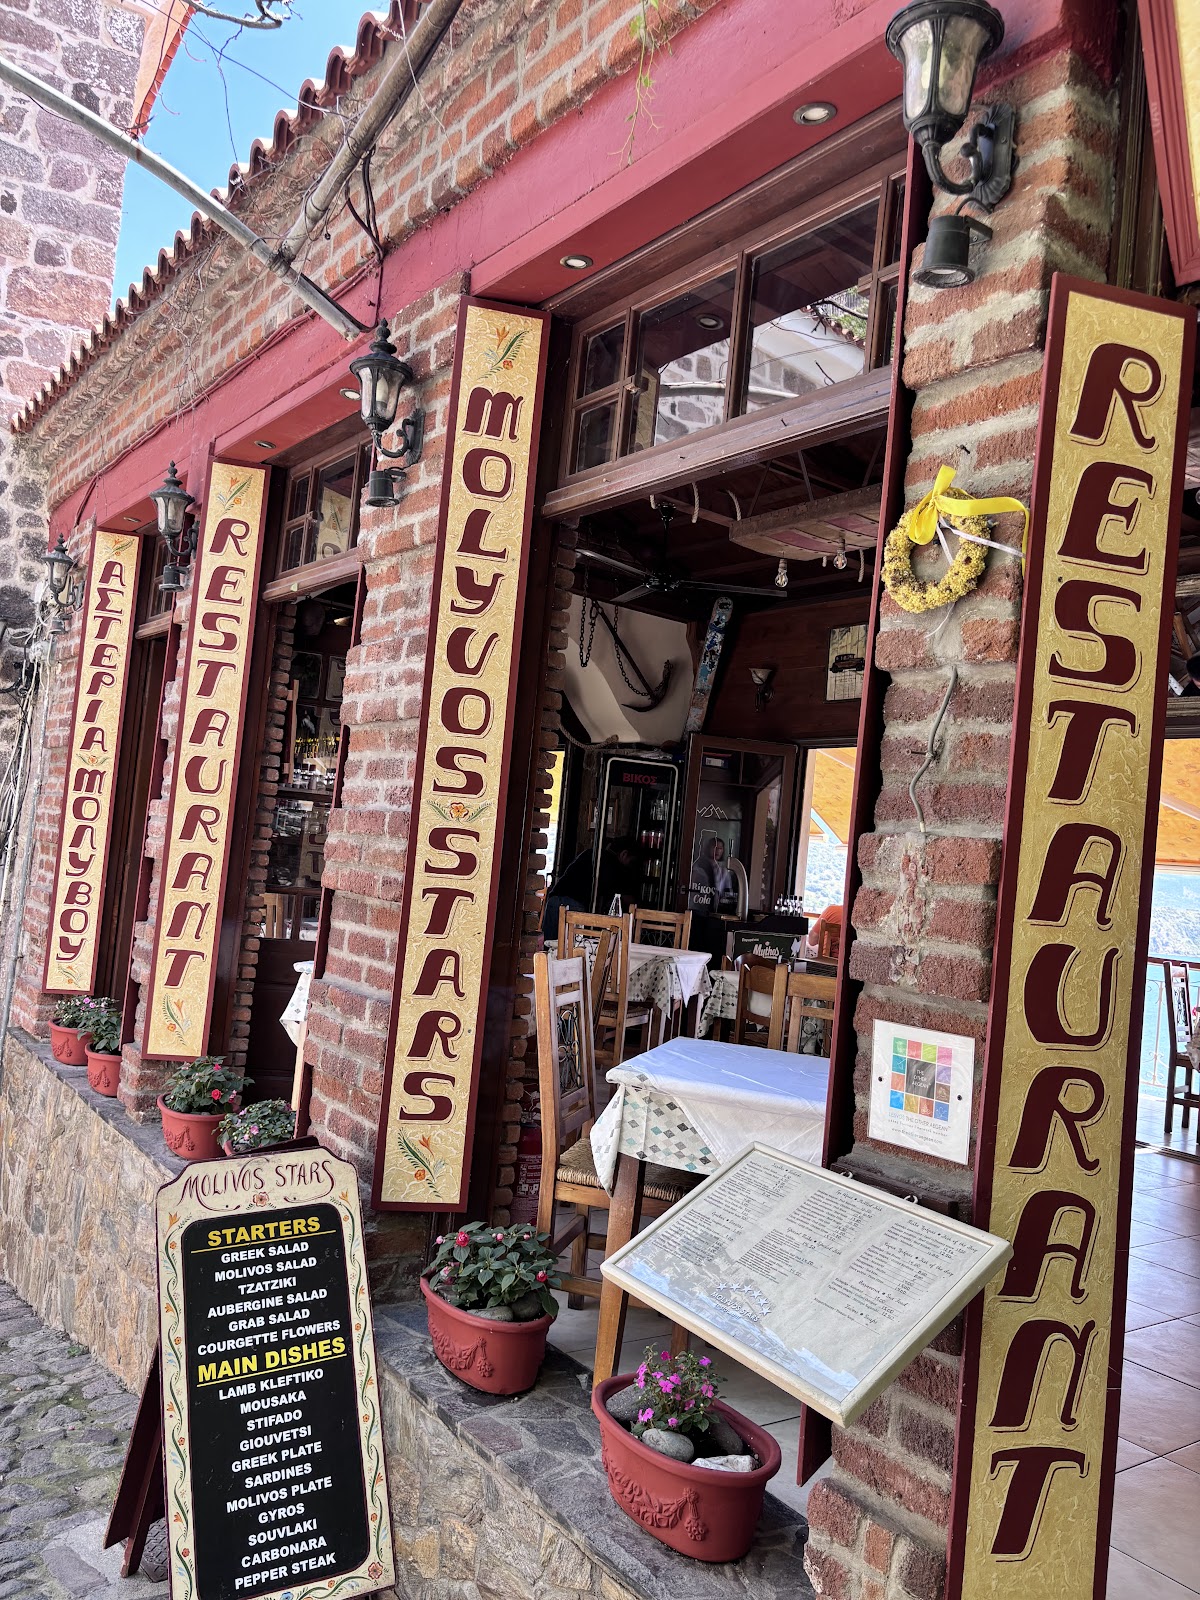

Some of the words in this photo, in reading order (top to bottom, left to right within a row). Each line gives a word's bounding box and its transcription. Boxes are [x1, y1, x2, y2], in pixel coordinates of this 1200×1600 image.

[433, 386, 524, 796] MOLYVOS
[164, 518, 251, 987] RESTAURANT
[693, 895, 711, 905] Cola
[753, 944, 780, 958] Mythos
[988, 342, 1164, 1558] RESTAURANT
[398, 827, 480, 1122] STARS
[177, 1158, 265, 1206] MOLIVOS
[275, 1160, 335, 1201] STARS
[208, 1216, 320, 1247] STARTERS
[221, 1248, 264, 1263] GREEK
[268, 1242, 309, 1256] SALAD
[215, 1264, 273, 1282] MOLIVOS
[276, 1257, 316, 1272] SALAD
[238, 1277, 296, 1295] TZATZIKI
[208, 1297, 283, 1318] AUBERGINE
[287, 1288, 327, 1303] SALAD
[228, 1317, 265, 1332] GRAB
[269, 1309, 310, 1324] SALAD
[198, 1332, 278, 1355] COURGETTE
[282, 1320, 340, 1338] FLOWERS
[198, 1354, 258, 1382] MAIN
[265, 1337, 345, 1363] DISHES
[219, 1384, 256, 1400] LAMB
[260, 1368, 323, 1391] KLEFTIKO
[240, 1390, 306, 1414] MOUSAKA
[247, 1410, 302, 1431] STIFADO
[240, 1425, 312, 1451] GIOUVETSI
[232, 1451, 278, 1472] GREEK
[281, 1441, 322, 1460] PLATE
[245, 1463, 312, 1488] SARDINES
[227, 1488, 288, 1513] MOLIVOS
[292, 1476, 332, 1496] PLATE
[258, 1503, 305, 1524] GYROS
[248, 1519, 317, 1546] SOUVLAKI
[241, 1536, 327, 1568] CARBONARA
[235, 1566, 288, 1590] PEPPER
[291, 1553, 336, 1574] STEAK
